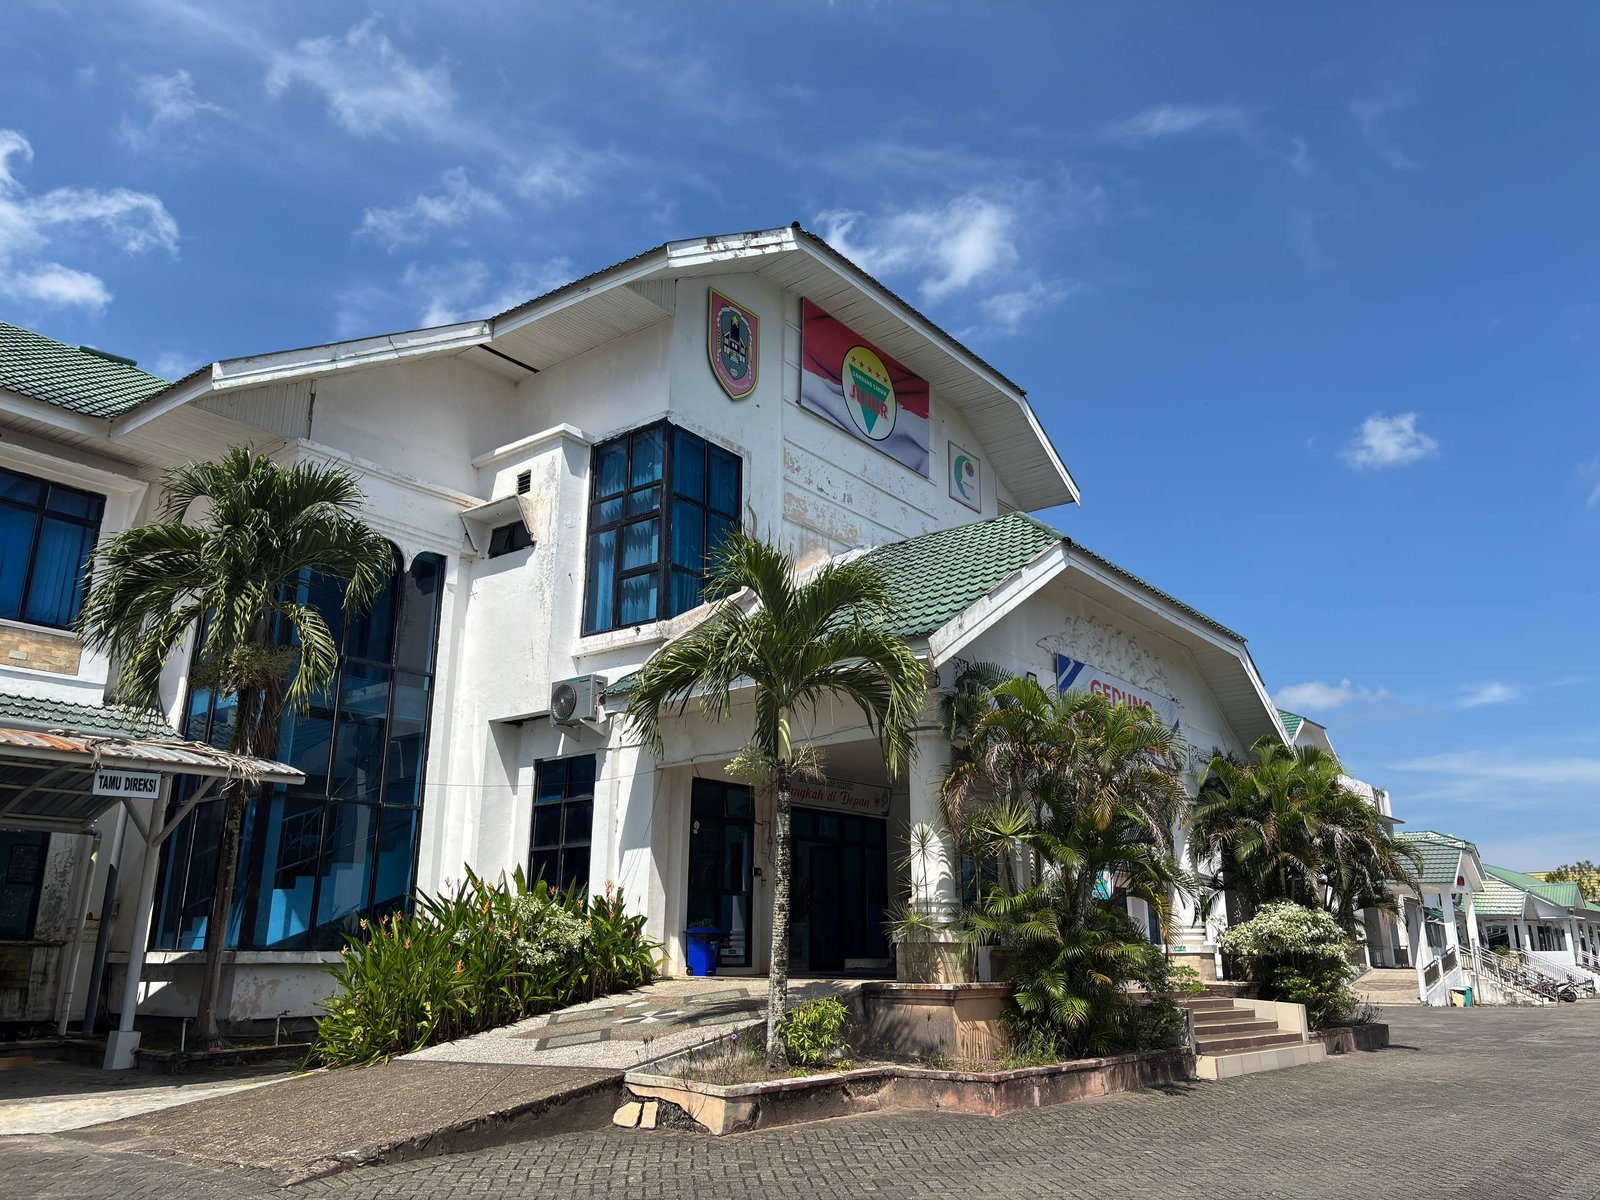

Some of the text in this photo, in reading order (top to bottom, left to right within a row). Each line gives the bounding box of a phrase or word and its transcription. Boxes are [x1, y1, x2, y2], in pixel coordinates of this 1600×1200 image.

[850, 383, 888, 419] JUJUR
[99, 775, 157, 792] TAMU DIREKSI
[790, 787, 870, 808] angkah di Depan
